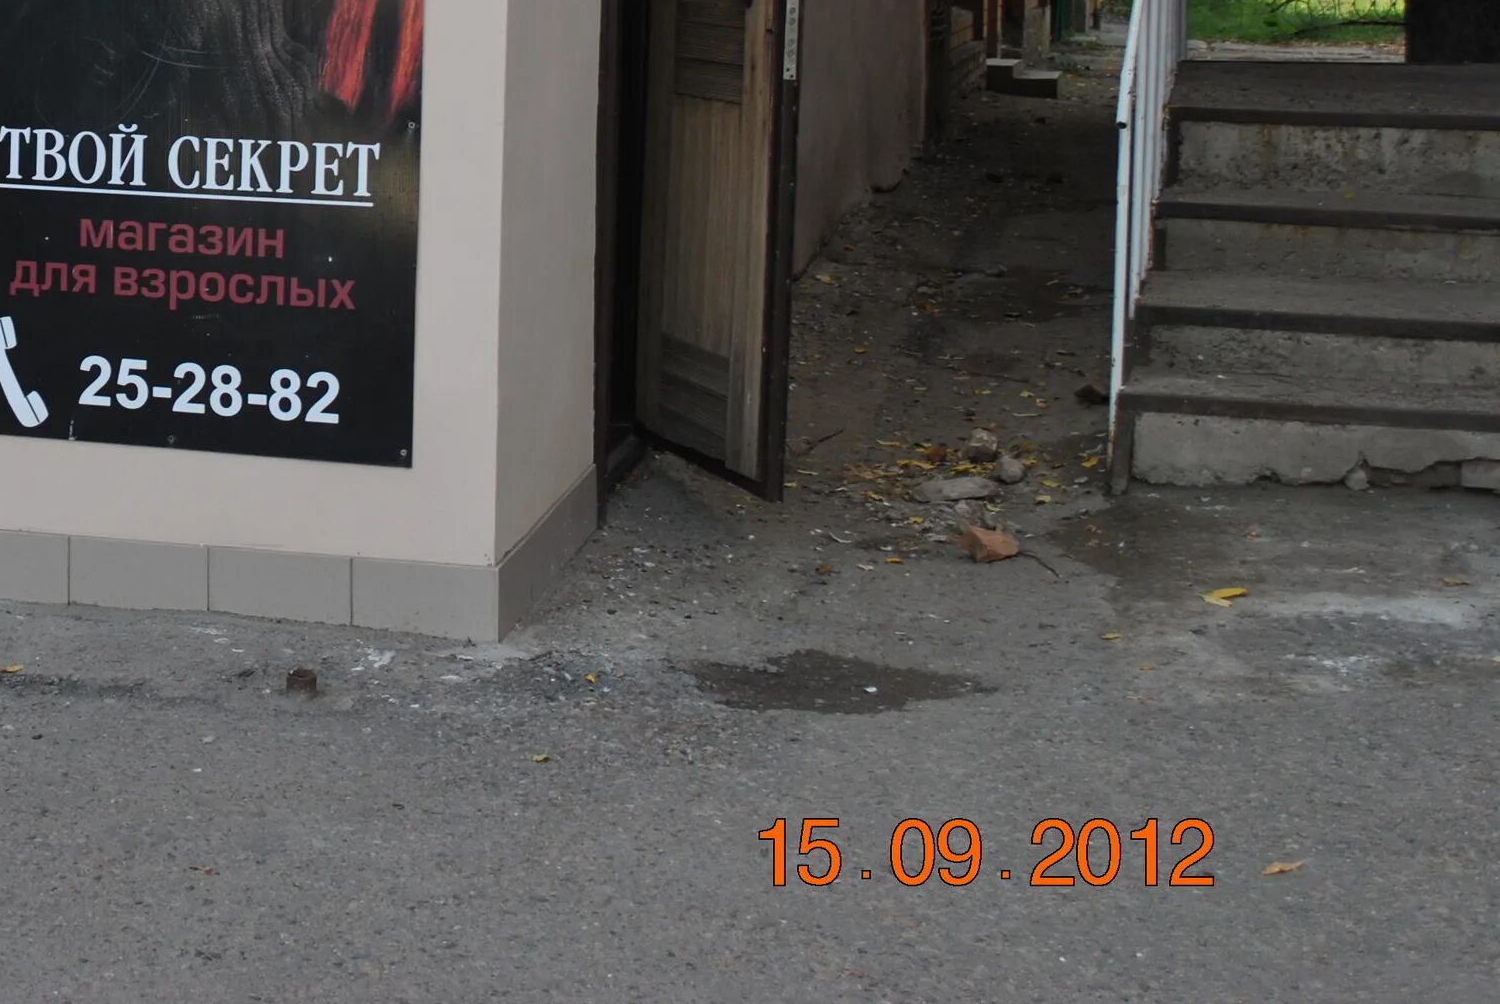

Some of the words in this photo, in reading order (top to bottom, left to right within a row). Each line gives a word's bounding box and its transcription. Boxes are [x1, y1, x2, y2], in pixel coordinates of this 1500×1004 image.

[0, 123, 149, 187] ТВОЙ
[167, 135, 381, 197] СЕКРЕТ
[79, 218, 285, 259] магазин
[8, 259, 98, 297] для
[113, 265, 356, 310] взрослых
[77, 354, 341, 425] 25-28-82
